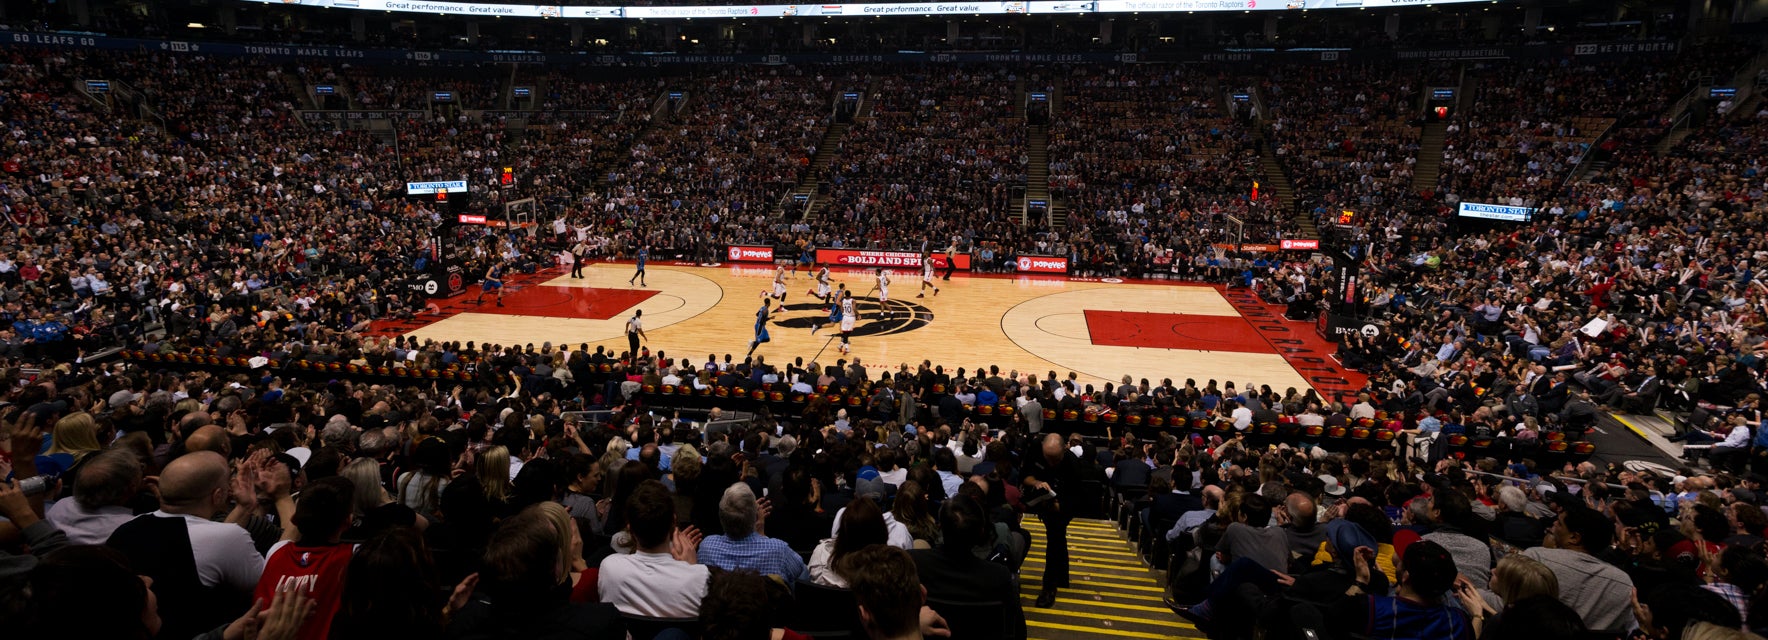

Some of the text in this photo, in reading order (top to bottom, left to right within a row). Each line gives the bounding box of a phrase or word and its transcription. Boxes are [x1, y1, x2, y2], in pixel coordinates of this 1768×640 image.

[385, 1, 515, 14] Great performance. Great value.
[1195, 1, 1218, 9] Toronto
[1219, 0, 1244, 10] Raptors
[727, 7, 748, 16] Raptors
[885, 6, 933, 14] performance.
[13, 34, 95, 47] GO LEAFS GO
[172, 42, 188, 51] 115
[1576, 42, 1674, 54] 122 WE THE NORTH
[244, 46, 364, 58] TORONTO MAPLE LEAFS
[507, 54, 532, 62] LEAFS
[985, 54, 1082, 62] TORONTO MAPLE LEAFS
[444, 181, 462, 189] STAR
[1468, 204, 1507, 214] TORONTO
[743, 250, 773, 258] POPEYES
[847, 256, 876, 264] BOLD
[877, 257, 902, 265] AND
[1033, 261, 1066, 269] POPEYES
[844, 305, 852, 314] 10
